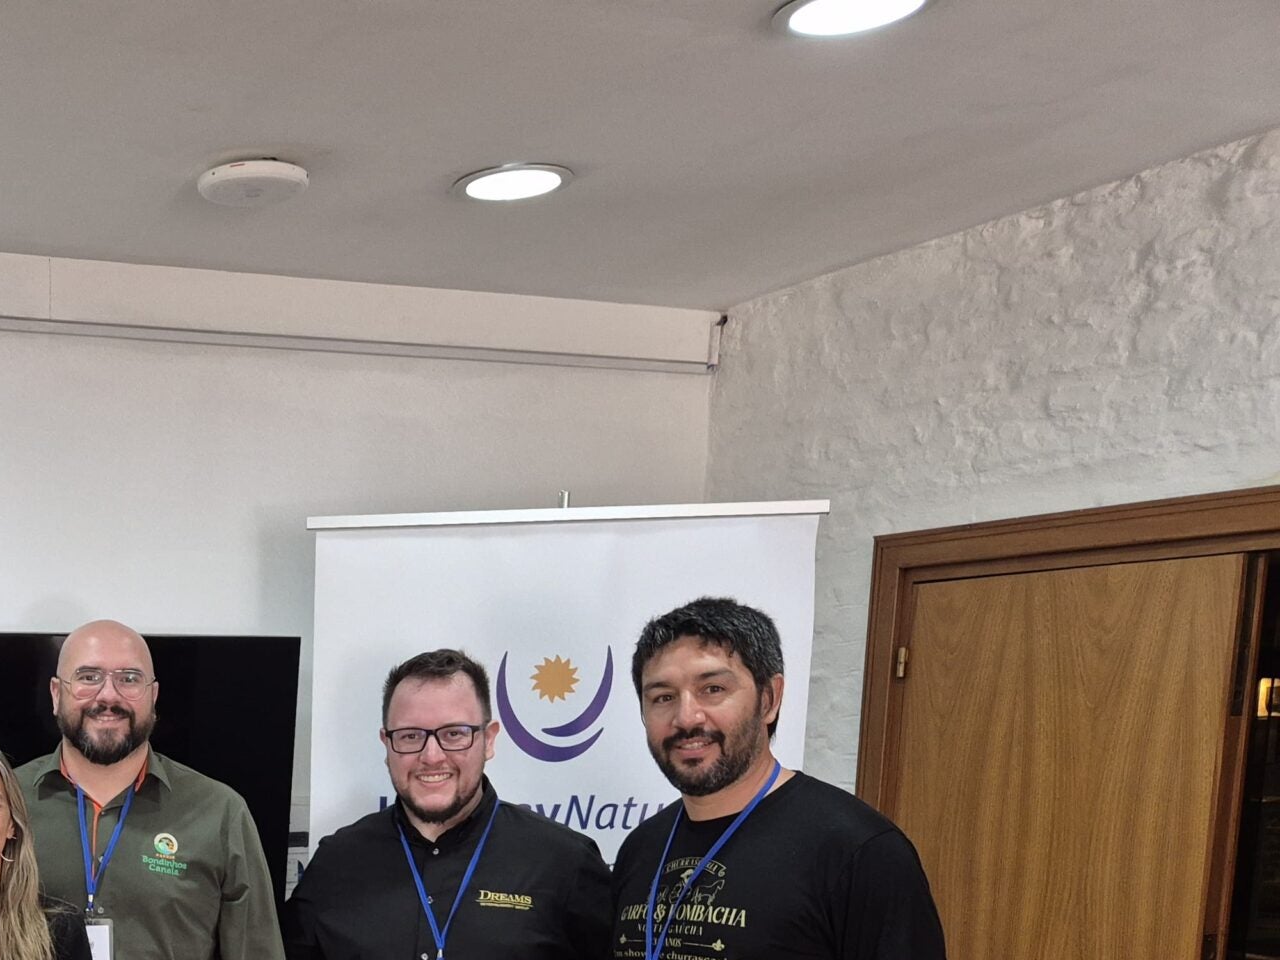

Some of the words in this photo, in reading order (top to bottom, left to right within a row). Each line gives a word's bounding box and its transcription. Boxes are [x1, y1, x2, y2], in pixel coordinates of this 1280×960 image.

[478, 889, 532, 905] DREAMS
[653, 904, 667, 923] &
[669, 904, 747, 928] OMBACHA
